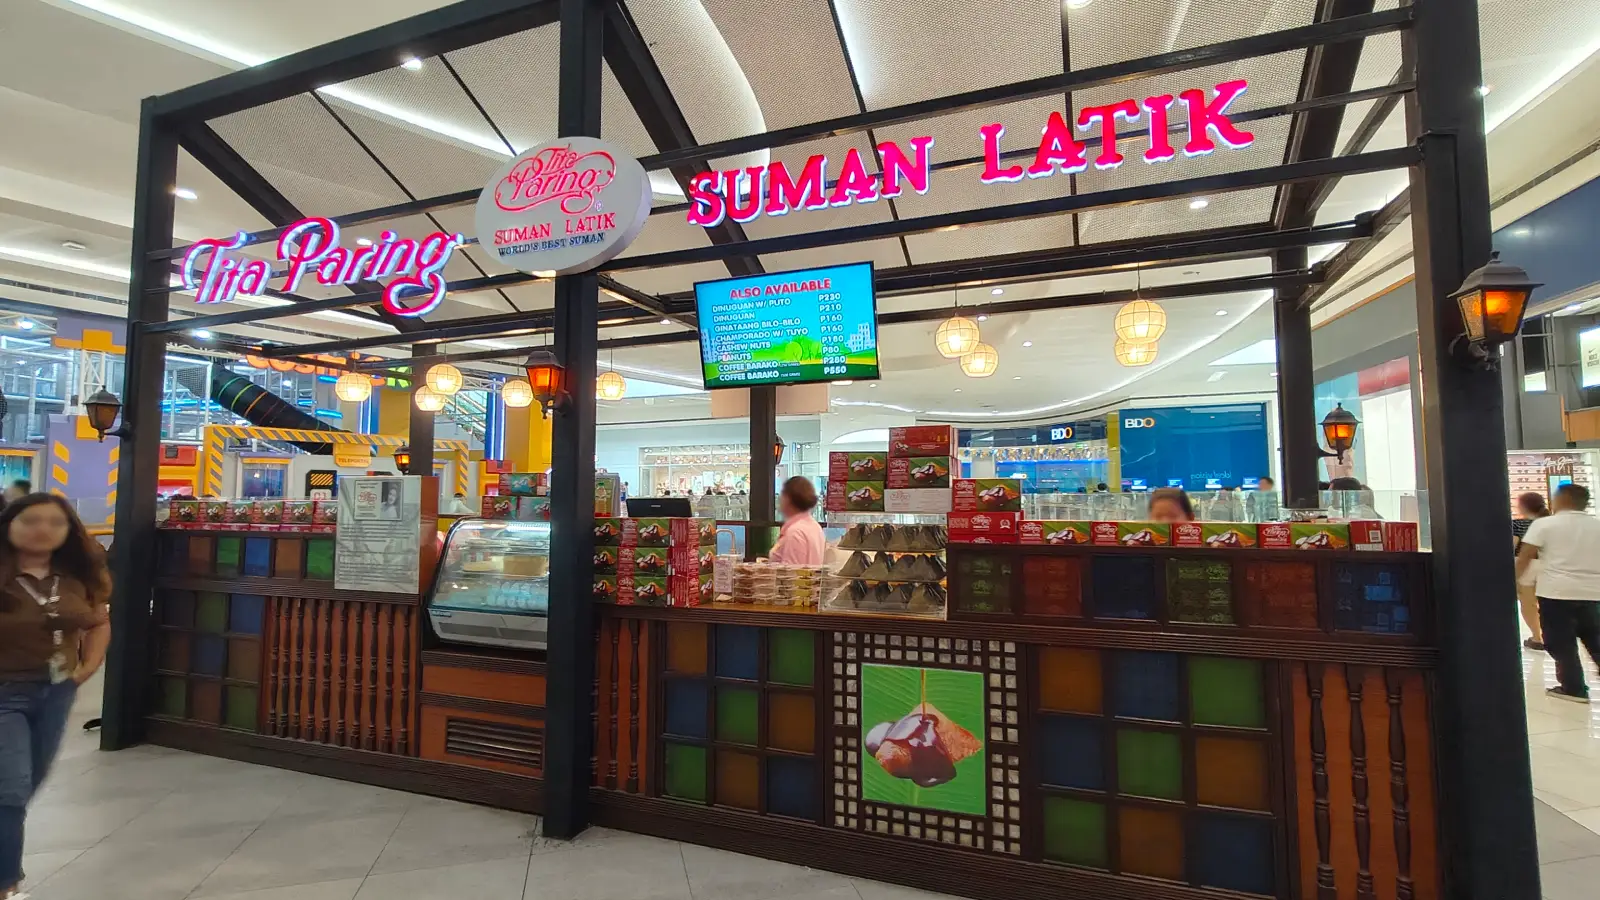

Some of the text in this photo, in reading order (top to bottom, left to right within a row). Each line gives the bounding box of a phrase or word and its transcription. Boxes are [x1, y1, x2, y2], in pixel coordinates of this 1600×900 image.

[532, 144, 580, 172] Tita
[687, 79, 1255, 227] SUMAN LATIK
[499, 155, 611, 215] Paring
[494, 212, 617, 246] SUMAN LATIK
[498, 233, 605, 257] WORLD'S BEST SUMAN
[181, 217, 464, 317] Tita Paring
[730, 278, 831, 299] ALSO AVAILABLE
[712, 292, 841, 313] DINUGUAN W/ PUTO P230
[713, 303, 841, 322] DINUGUAN P210
[761, 318, 801, 328] BILO-BILO
[820, 314, 842, 323] P160
[715, 325, 843, 343] CHAMPORADO W/ TUYO P160
[716, 343, 748, 352] CASHEW
[750, 341, 771, 350] NUTS
[717, 352, 751, 362] PEANUTS
[718, 363, 744, 372] COFFEE
[746, 361, 778, 370] BARAKO
[719, 373, 746, 382] COFFEE
[747, 371, 780, 380] BARAKO
[824, 366, 847, 375] P550
[1125, 417, 1155, 429] BDO
[1051, 426, 1073, 441] BDO
